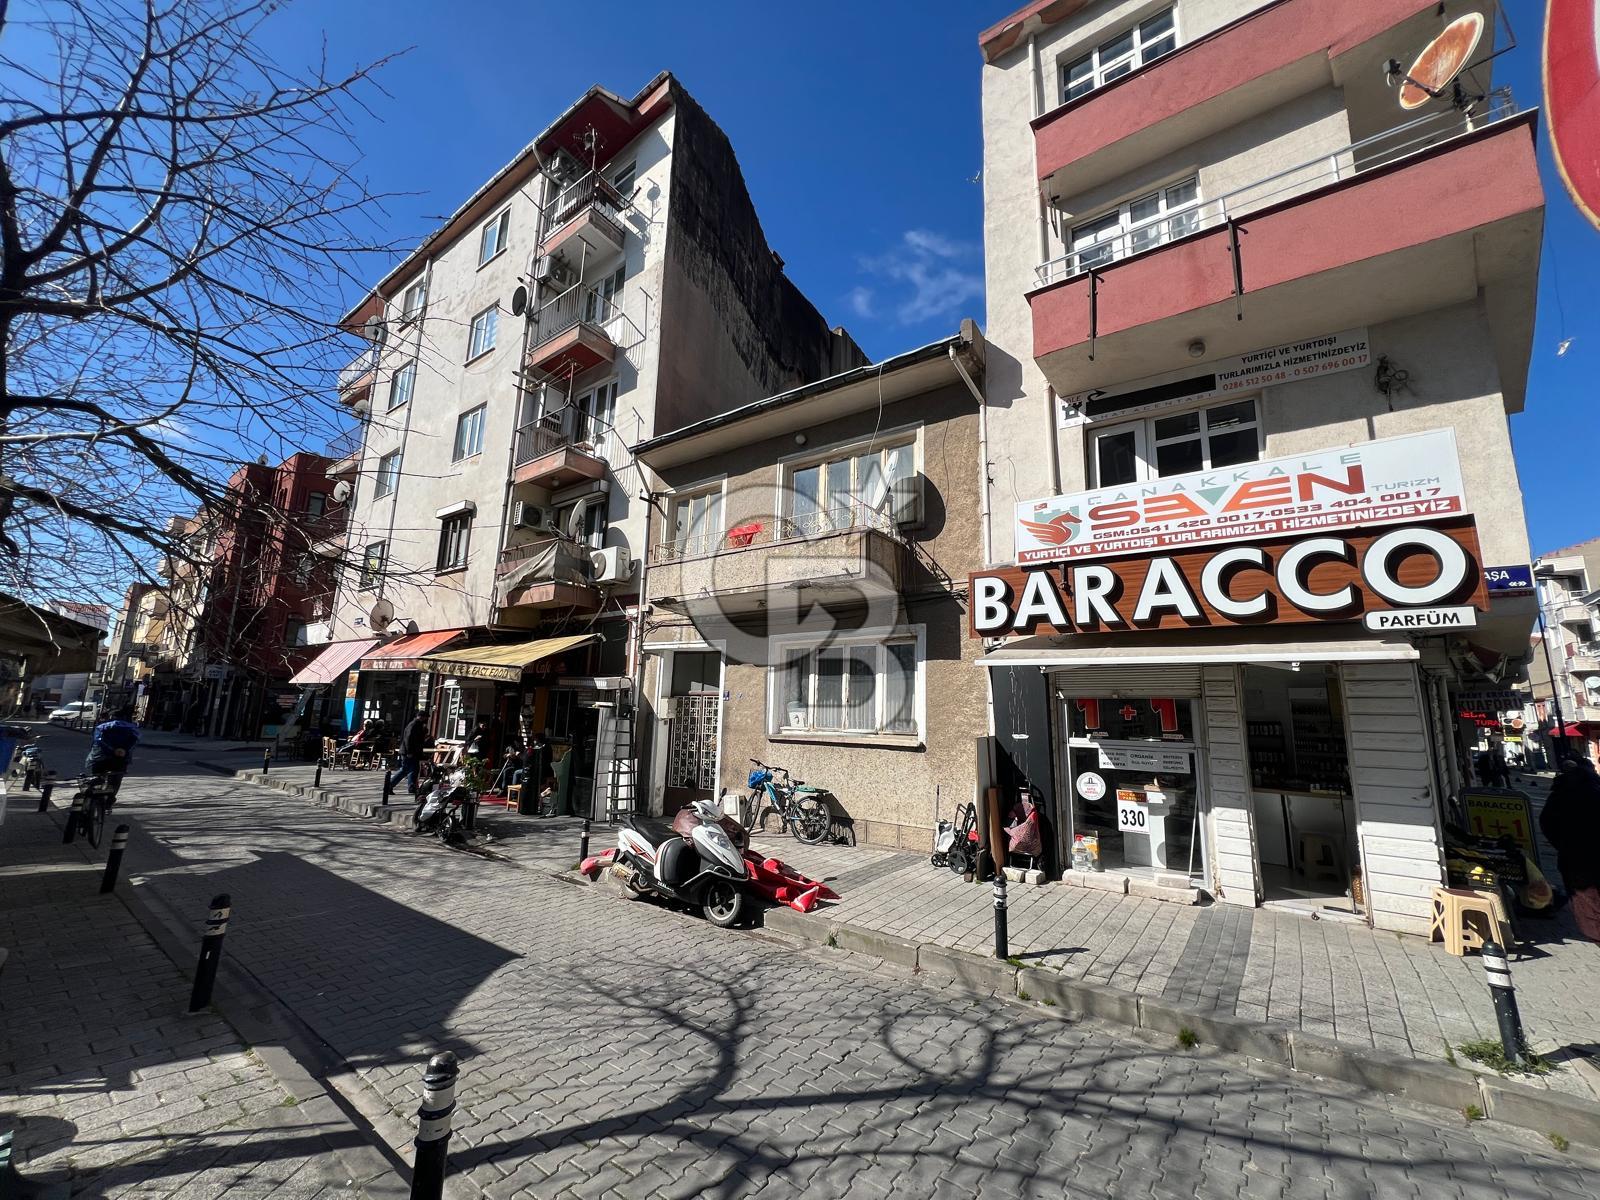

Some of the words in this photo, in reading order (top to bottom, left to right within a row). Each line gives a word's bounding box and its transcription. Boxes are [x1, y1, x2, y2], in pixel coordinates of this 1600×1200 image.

[1218, 362, 1281, 381] TURLARIMIZLA
[1283, 342, 1367, 367] HİZMETİNİZDEYİZ
[1241, 349, 1277, 364] YURTİÇİ
[1278, 347, 1290, 356] VE
[1292, 336, 1337, 353] YURTDIŞI
[1222, 381, 1244, 391] 0286
[1246, 377, 1260, 386] 512
[1261, 374, 1273, 383] 50
[1274, 371, 1286, 380] 48
[1294, 368, 1300, 376] 0
[1302, 364, 1319, 375] 507
[1322, 360, 1340, 371] 696
[1342, 358, 1356, 368] 00
[1358, 354, 1368, 363] 17
[1087, 452, 1361, 506] ÇANAKKALE
[1088, 464, 1366, 531] SEVEN
[1024, 546, 1070, 561] YURTİÇİ
[1074, 545, 1091, 554] VE
[1095, 536, 1157, 553] YURTDIŞI
[1163, 522, 1277, 545] TURLARIMIZLA
[1282, 497, 1451, 529] HİZMETİNİZDEYİZ
[1093, 525, 1169, 540] GSM:0541
[1177, 518, 1210, 529] 420
[1217, 504, 1322, 524] 0017-0533
[1330, 496, 1372, 508] 404
[1380, 487, 1441, 502] 0017
[974, 527, 1469, 635] BARACCO
[1379, 605, 1461, 628] PARFÜM
[1121, 808, 1145, 827] 330
[1468, 799, 1523, 811] BARACCO
